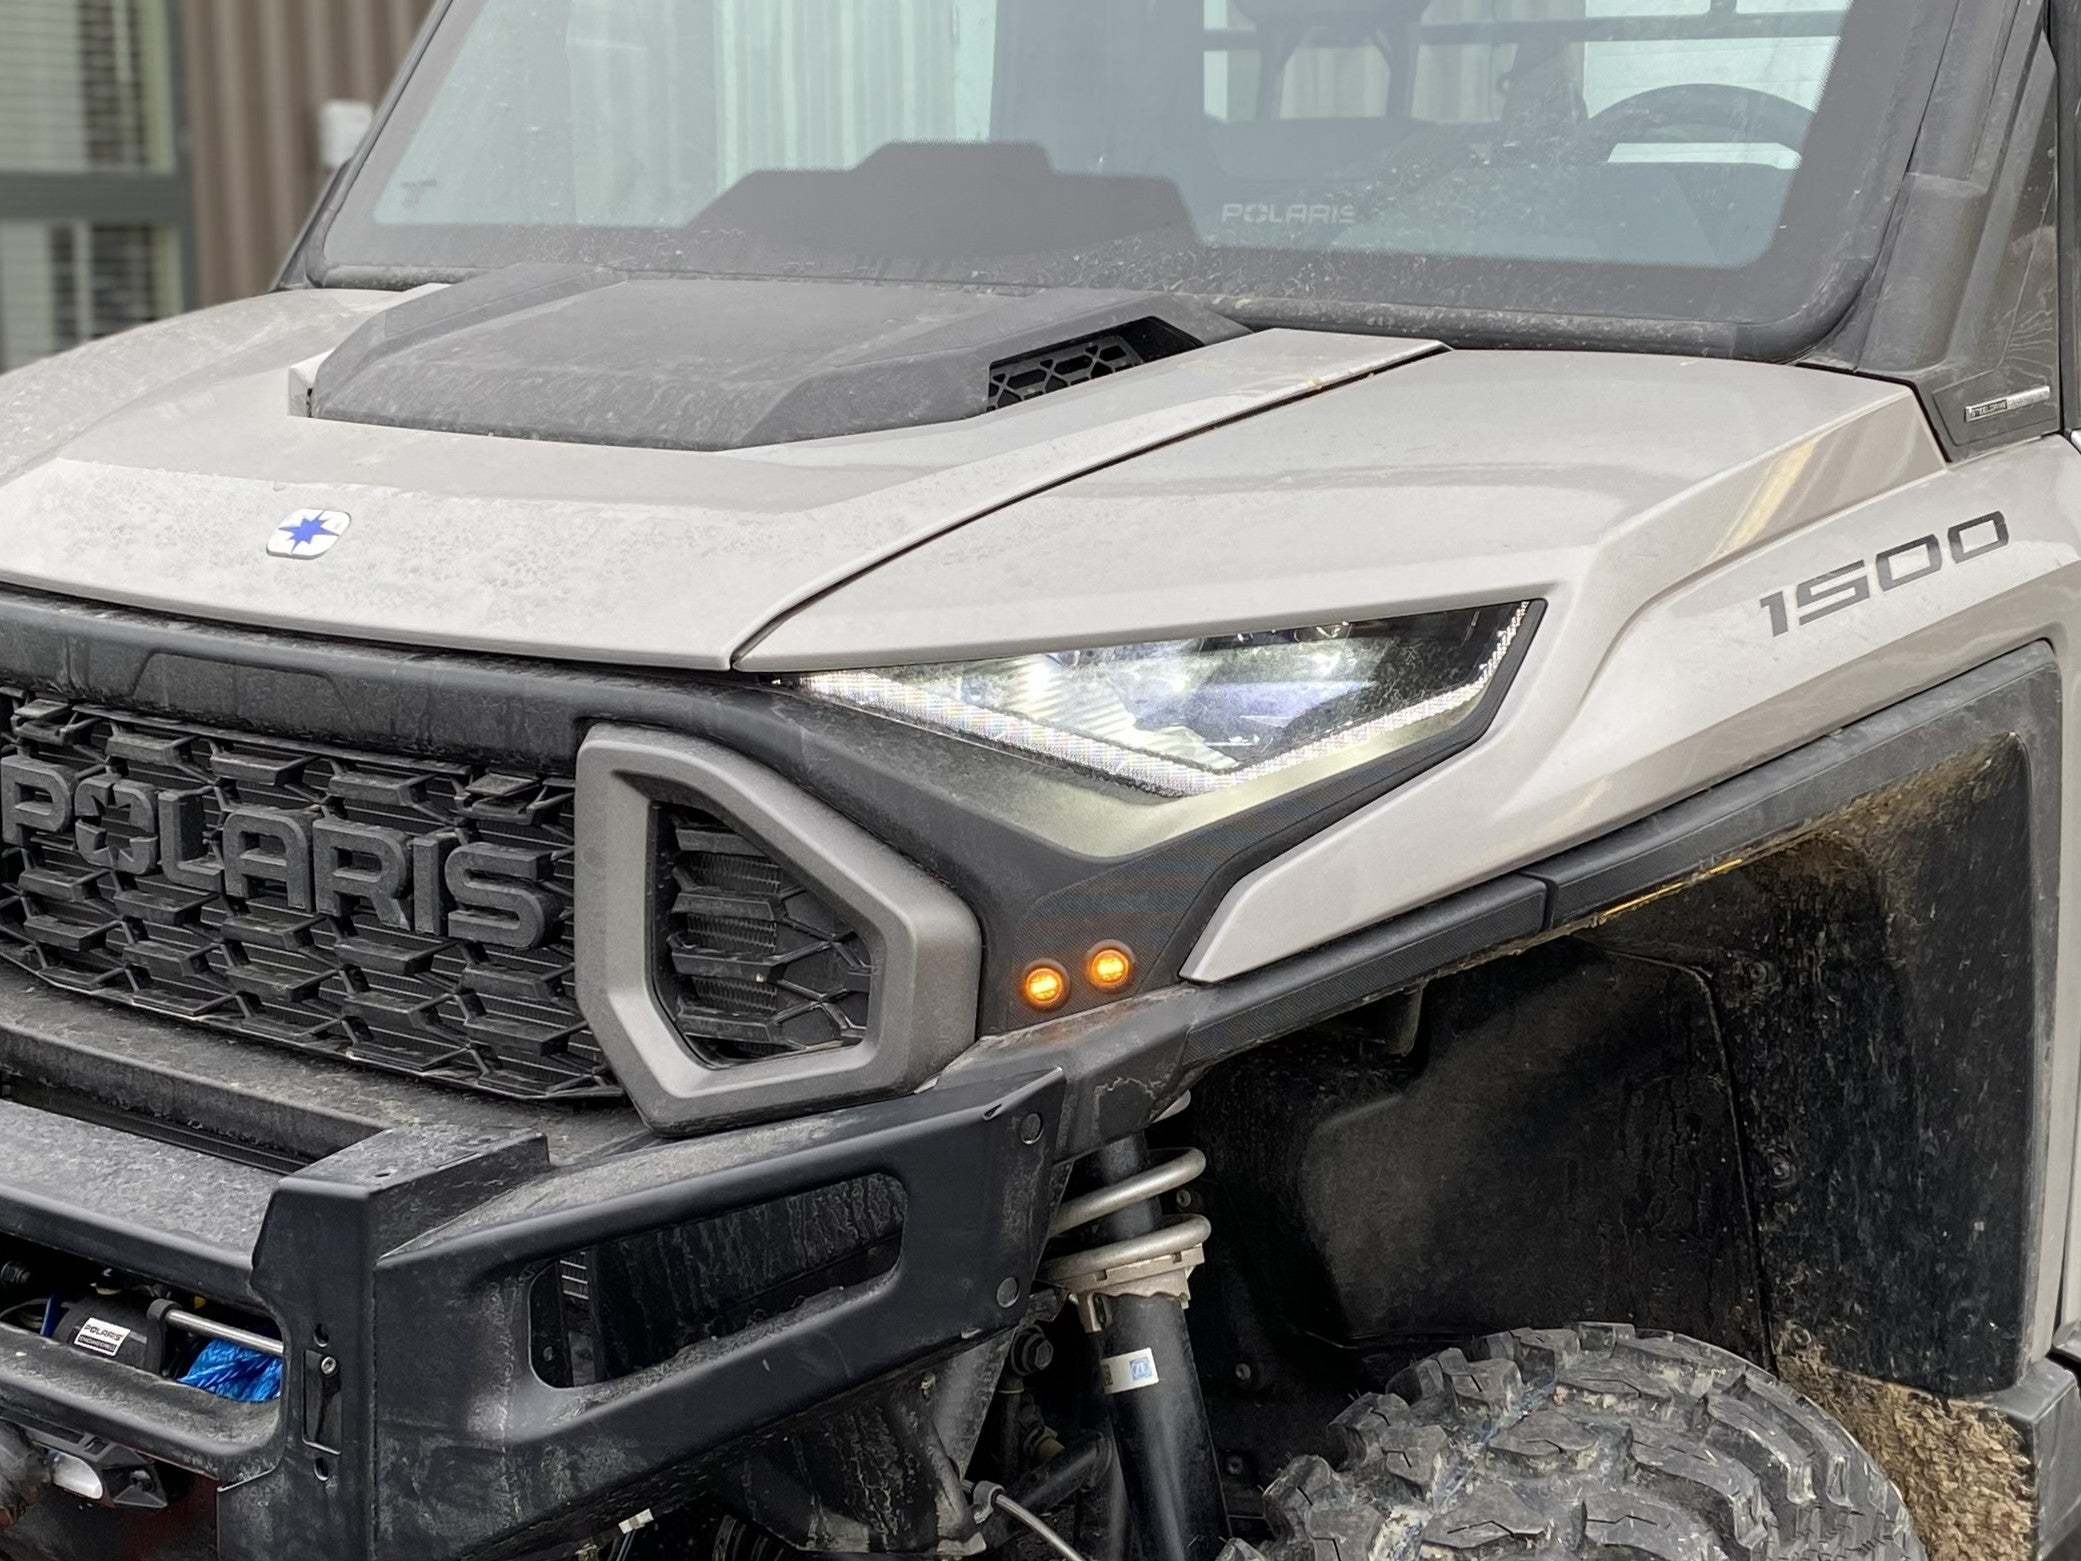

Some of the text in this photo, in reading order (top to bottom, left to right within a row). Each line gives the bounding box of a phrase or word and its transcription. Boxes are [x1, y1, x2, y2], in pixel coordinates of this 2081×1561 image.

[1221, 203, 1355, 224] POLARIS
[1760, 510, 2009, 637] 1500
[1, 755, 562, 950] POLARIS
[84, 1324, 124, 1341] POLARIS
